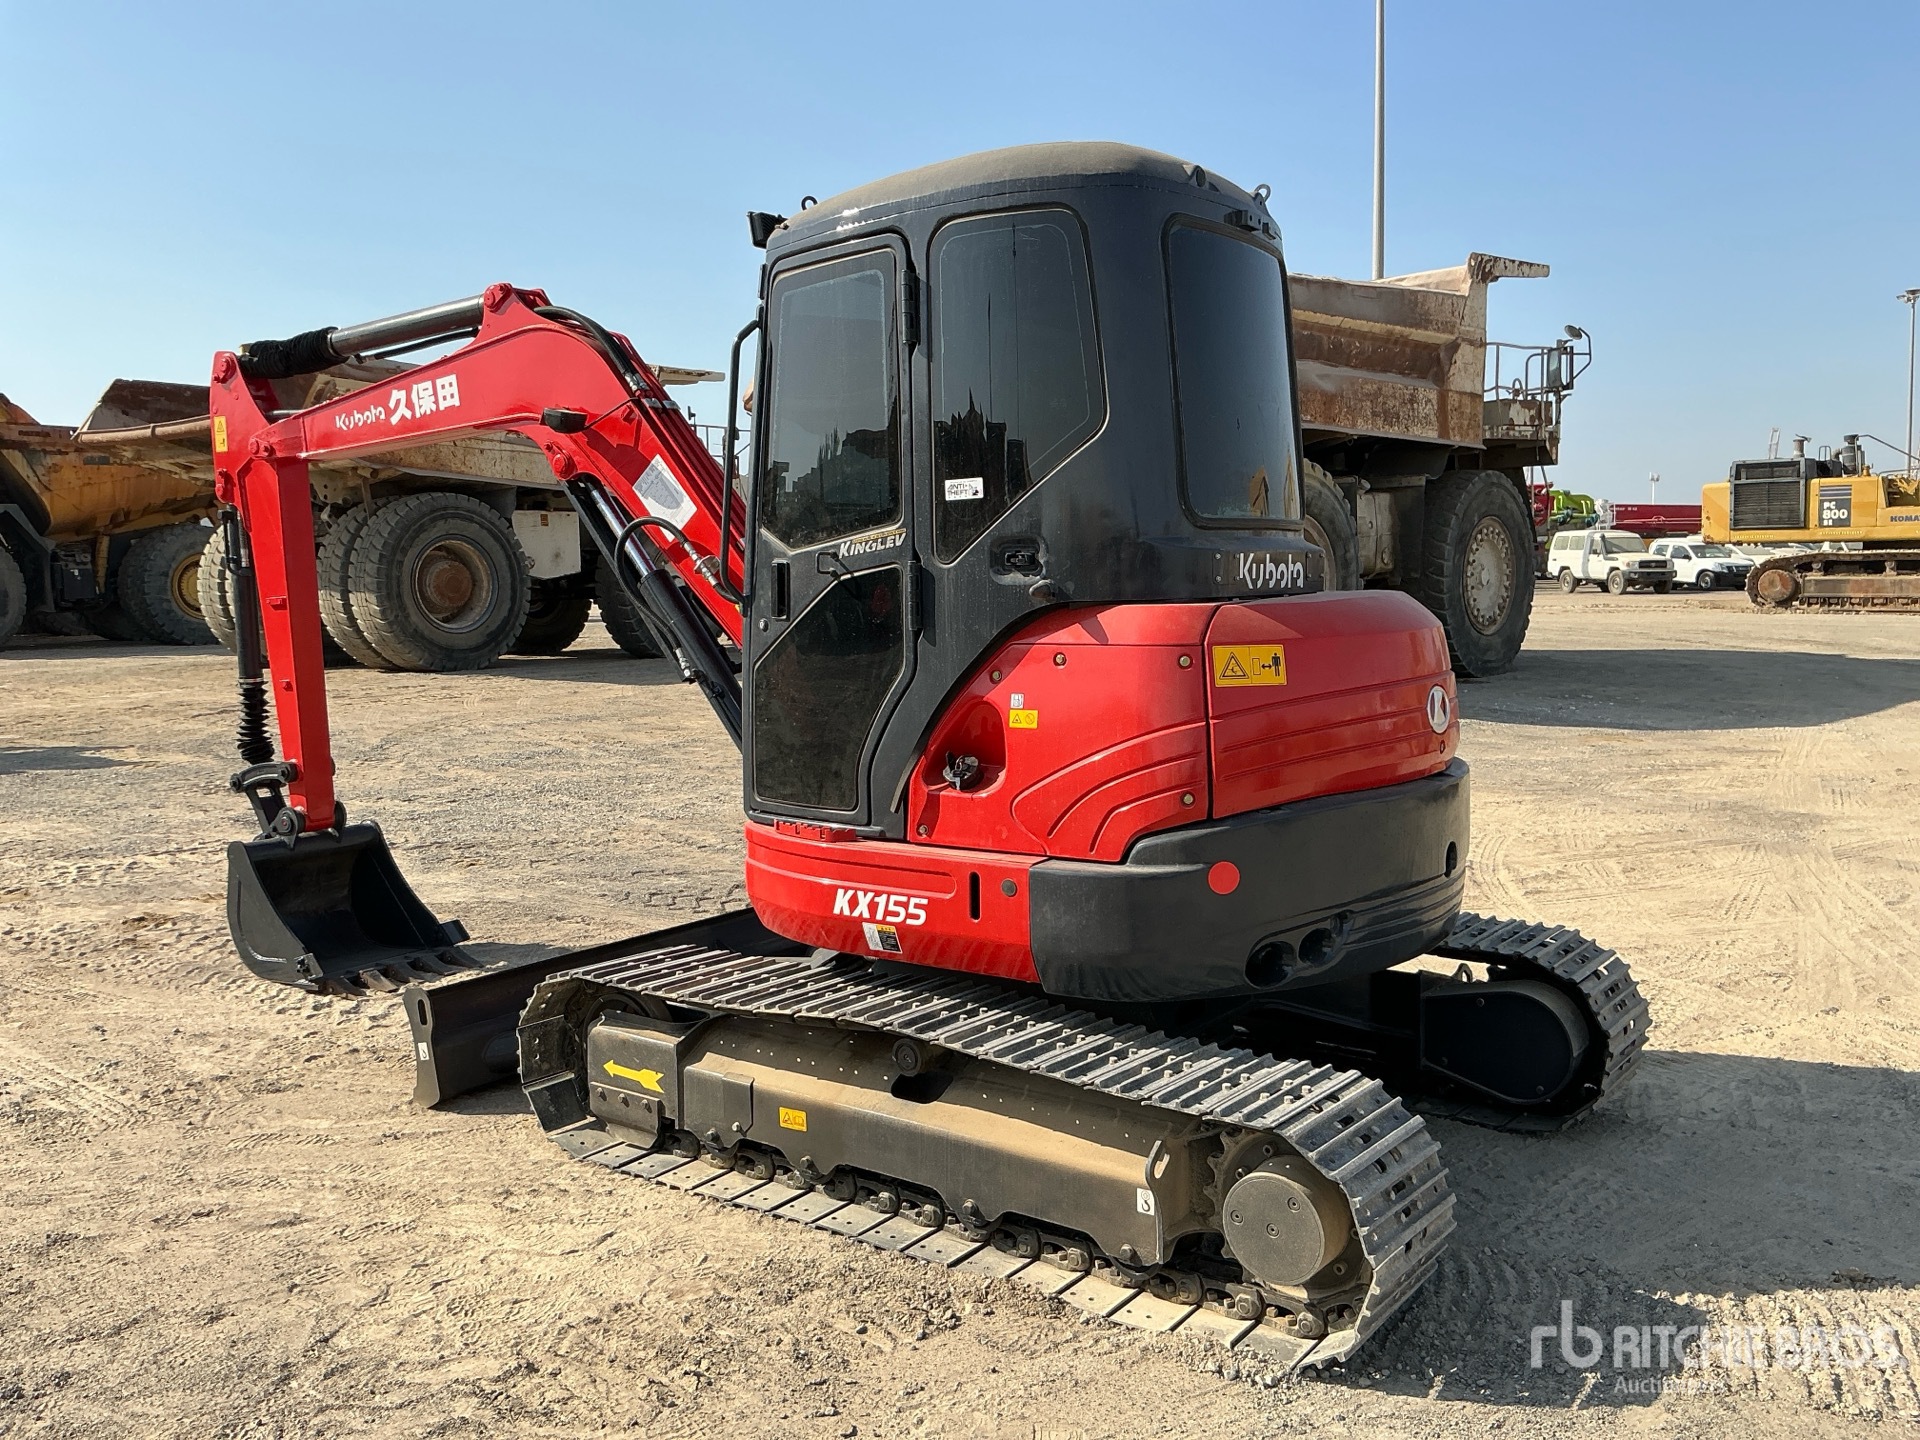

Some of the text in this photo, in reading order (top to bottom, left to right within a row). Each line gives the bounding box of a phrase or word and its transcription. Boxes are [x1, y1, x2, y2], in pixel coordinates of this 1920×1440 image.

[388, 373, 460, 426] 久保田
[335, 404, 386, 430] Kubota
[1822, 509, 1848, 519] 800
[1823, 501, 1836, 509] PC
[1890, 514, 1920, 522] KOMA
[838, 532, 907, 559] KINGLEV
[1239, 552, 1304, 589] Kubota
[832, 888, 929, 926] KX155
